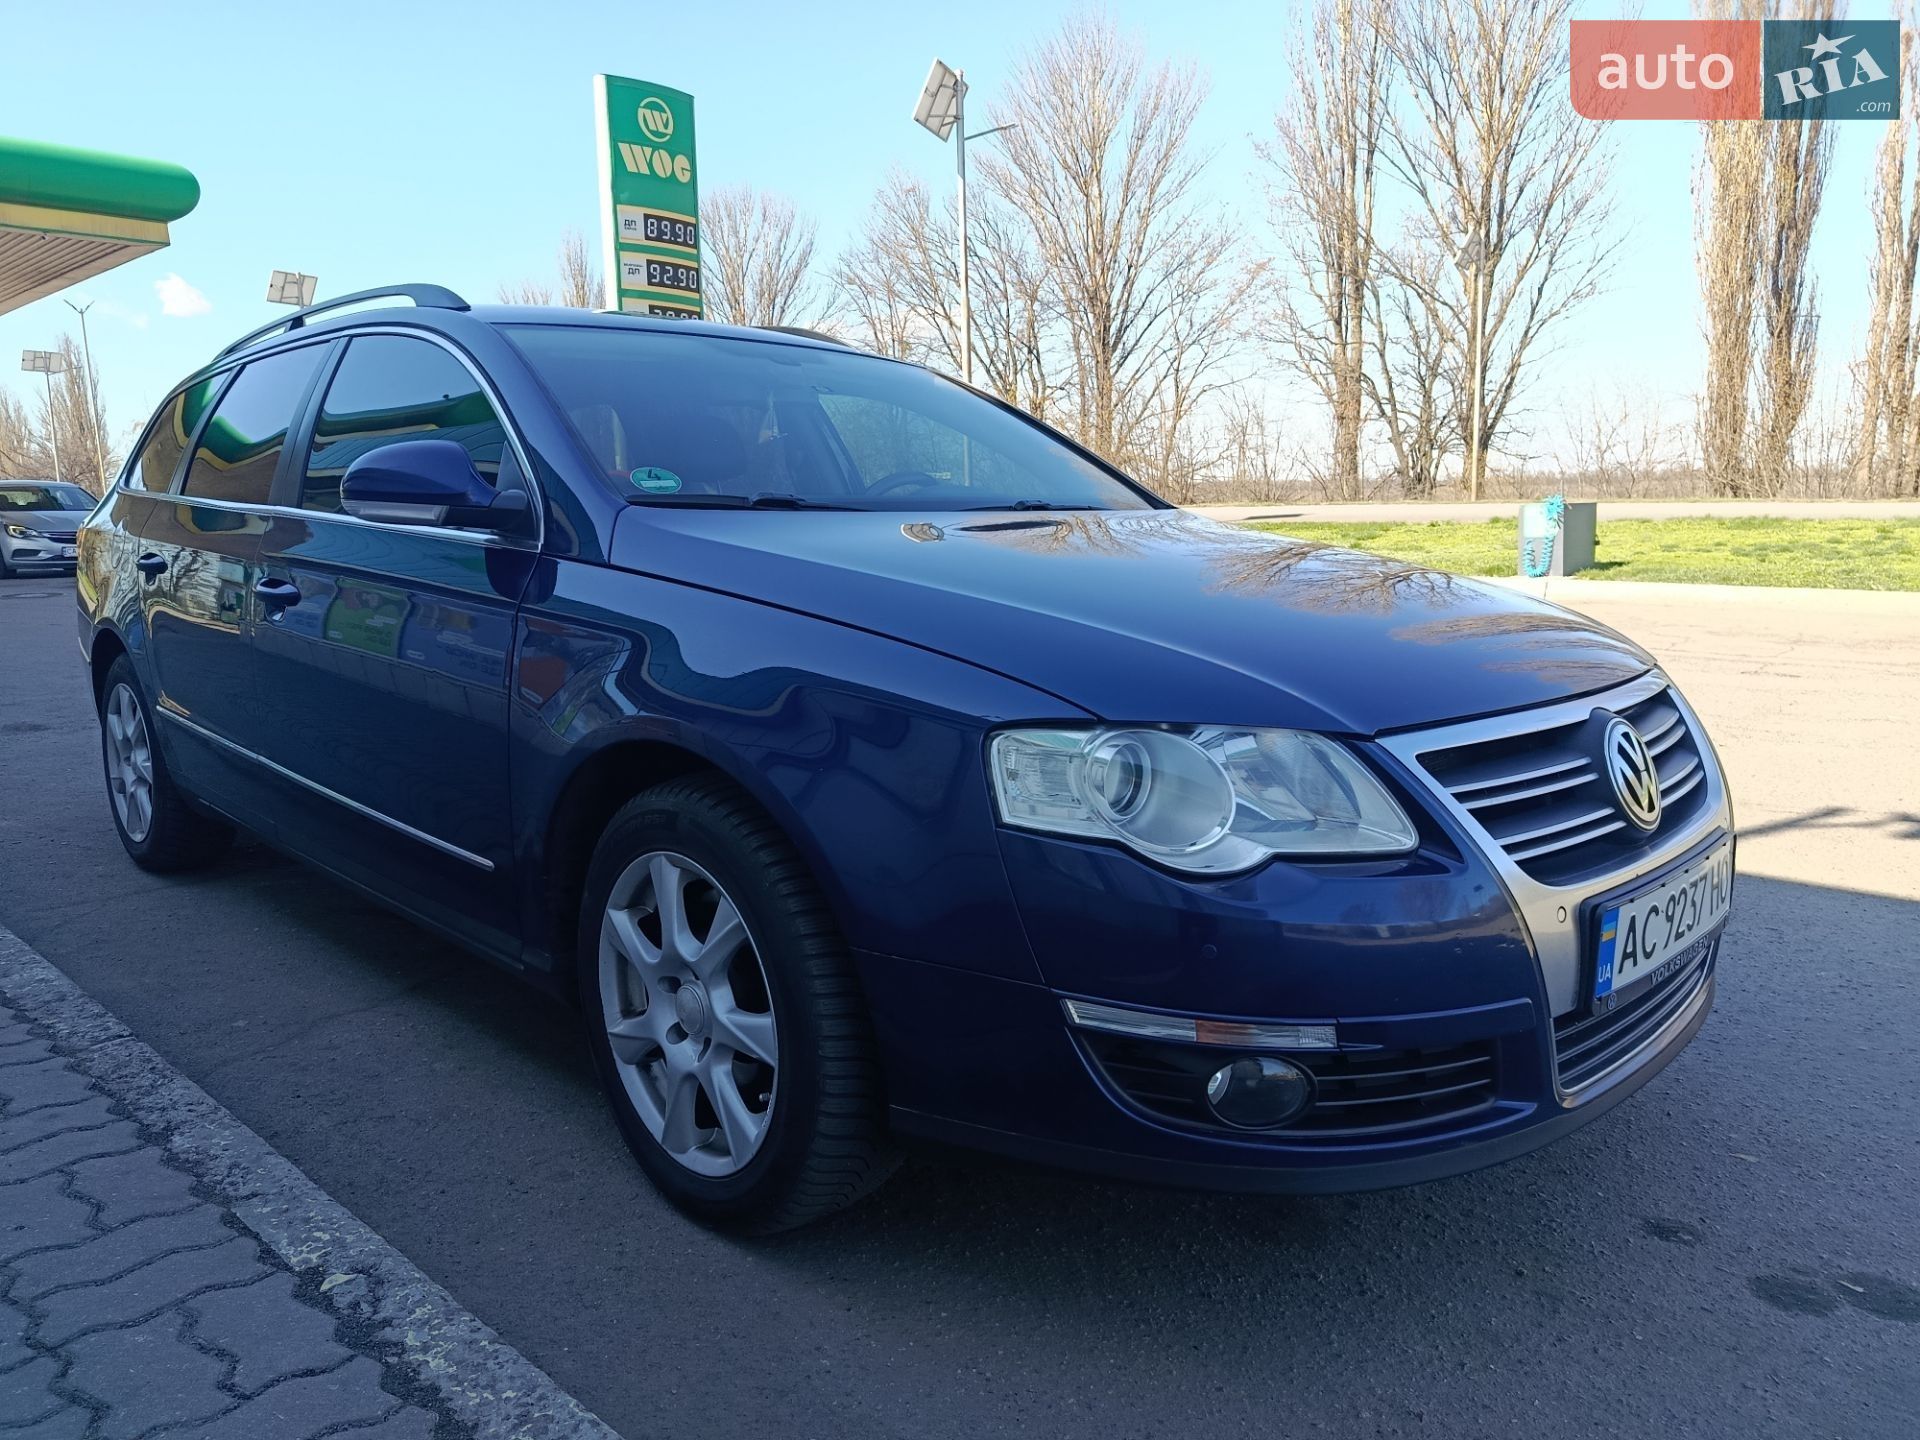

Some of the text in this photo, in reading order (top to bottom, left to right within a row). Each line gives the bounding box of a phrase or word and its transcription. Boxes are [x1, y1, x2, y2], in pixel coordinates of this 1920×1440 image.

[617, 142, 692, 184] WOG
[647, 218, 695, 245] 89.90
[650, 263, 697, 289] 92.90
[1618, 904, 1660, 974] AC
[1663, 873, 1707, 950] 9237
[1599, 963, 1611, 983] UA
[1651, 935, 1709, 986] VOLKSWAGEN
